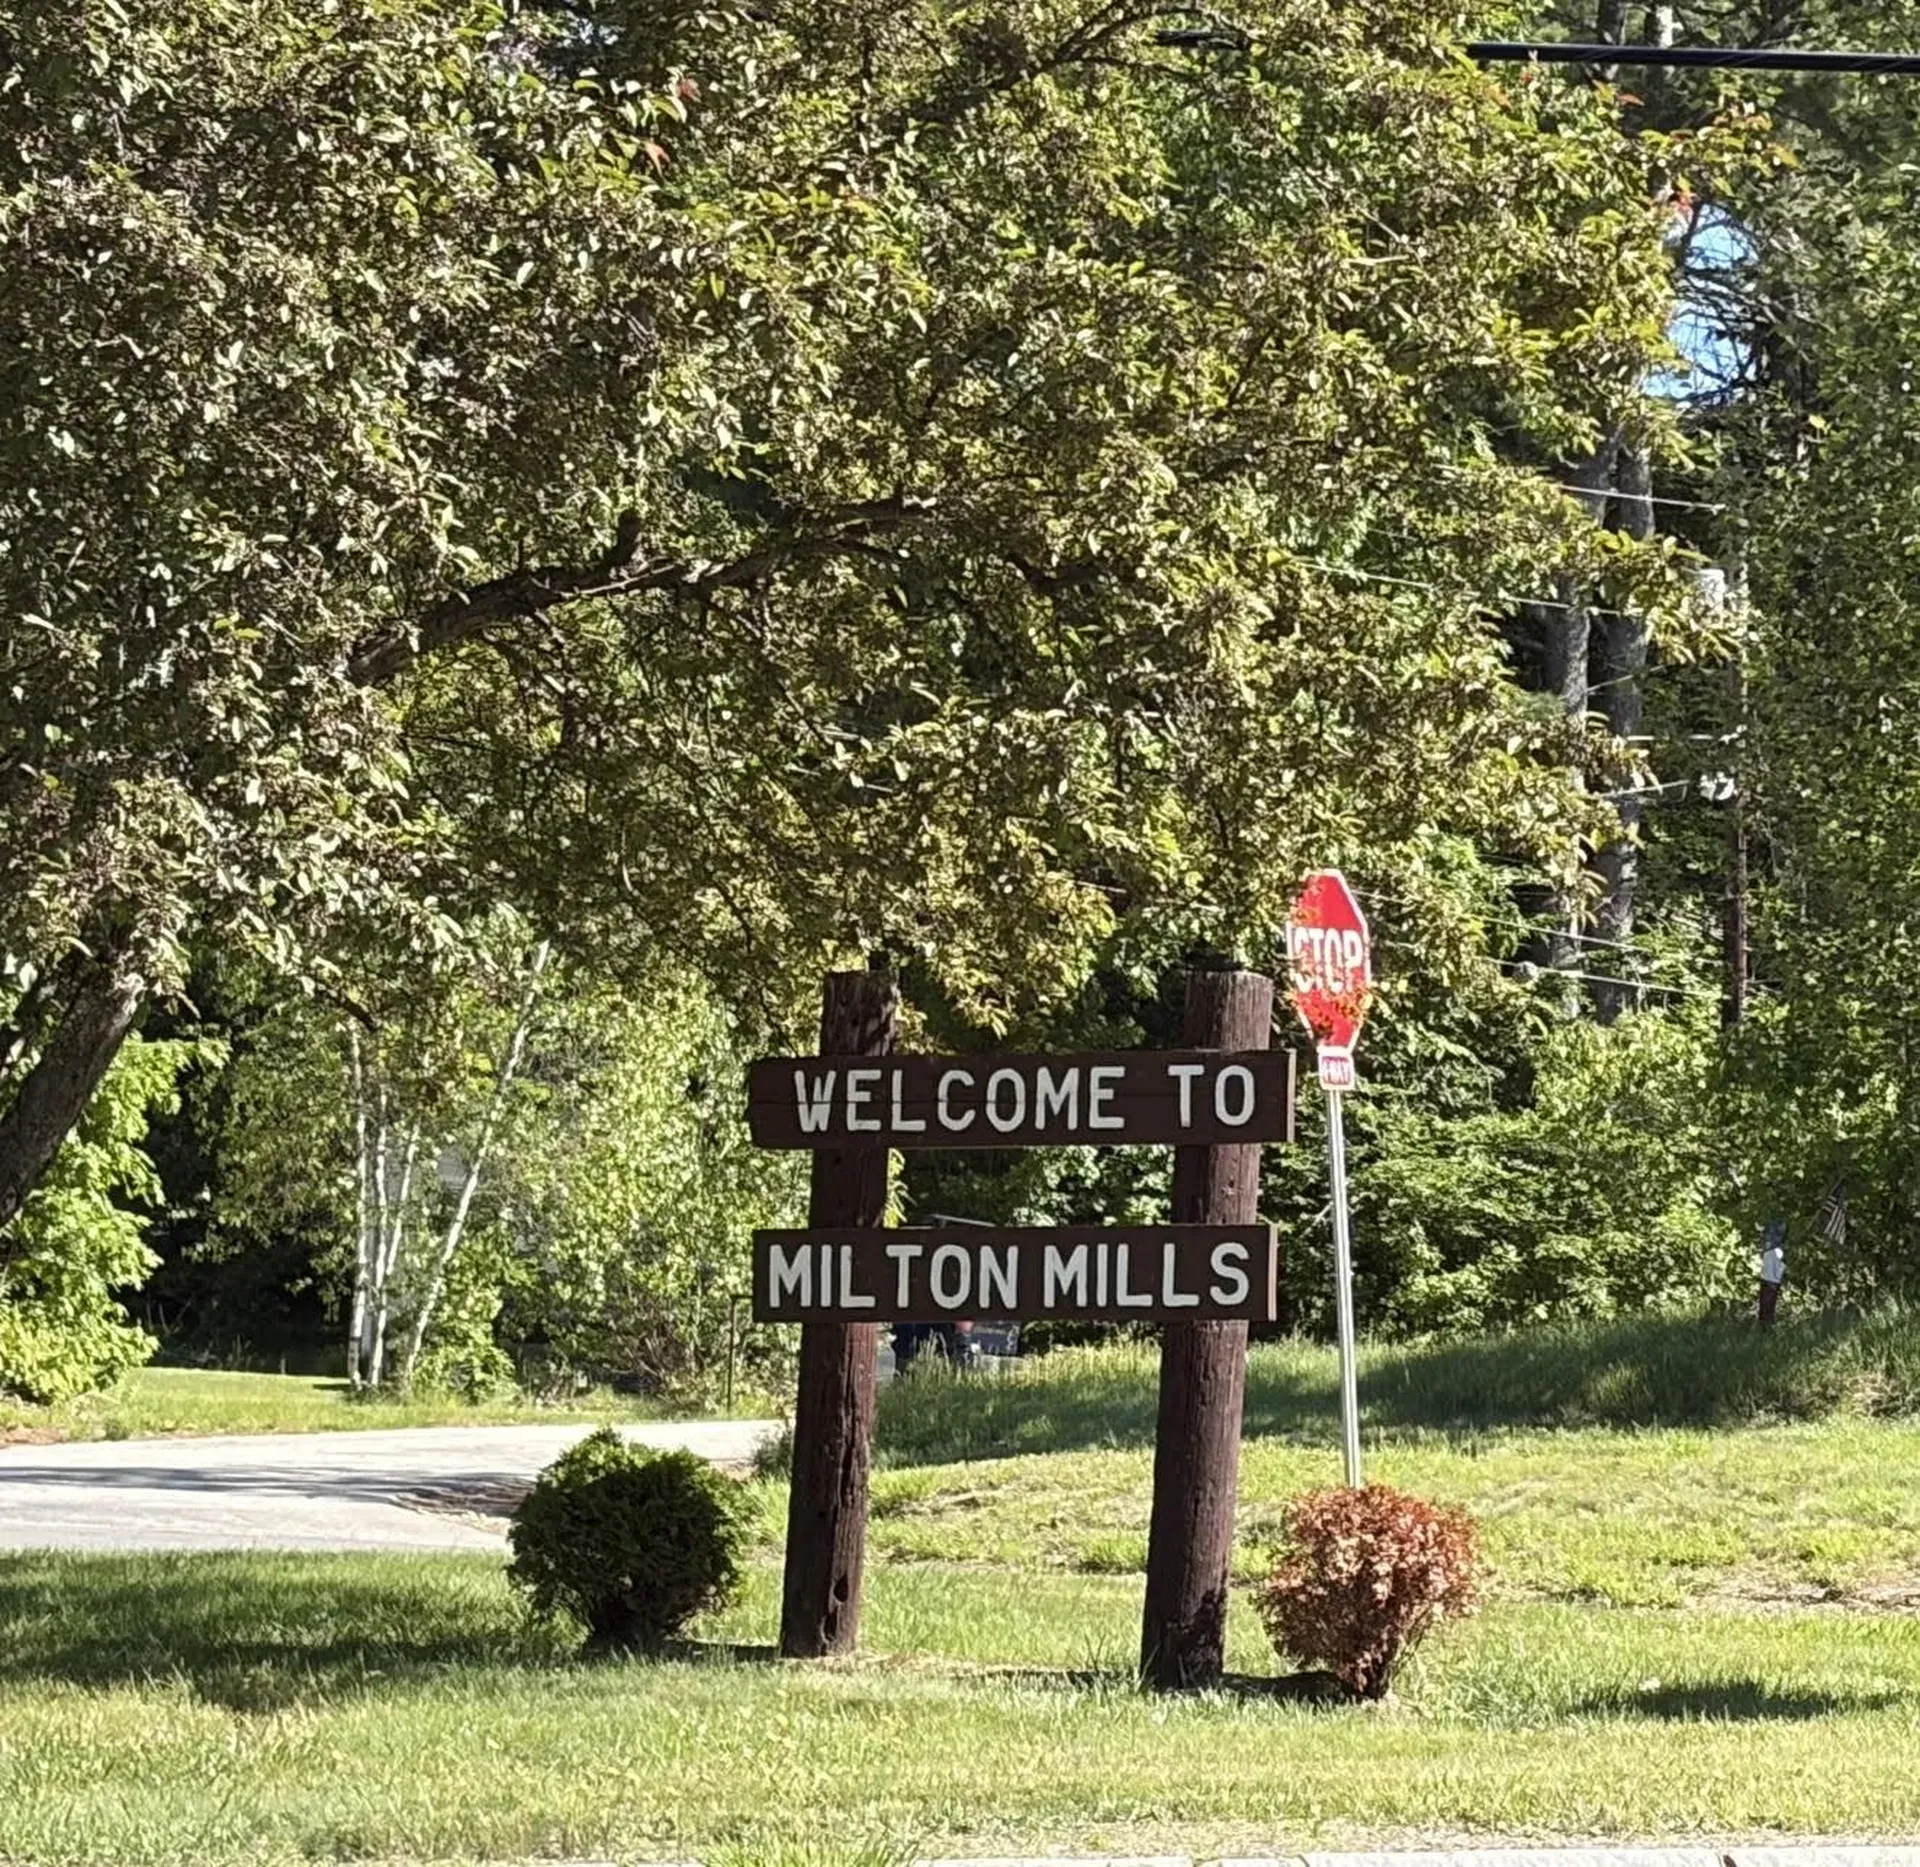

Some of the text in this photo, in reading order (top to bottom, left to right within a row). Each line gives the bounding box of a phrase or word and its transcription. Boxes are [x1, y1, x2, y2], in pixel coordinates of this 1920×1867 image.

[1294, 927, 1363, 994] STOP
[794, 1064, 1256, 1132] WELCOME TO
[769, 1242, 1250, 1309] MILTON MILLS
